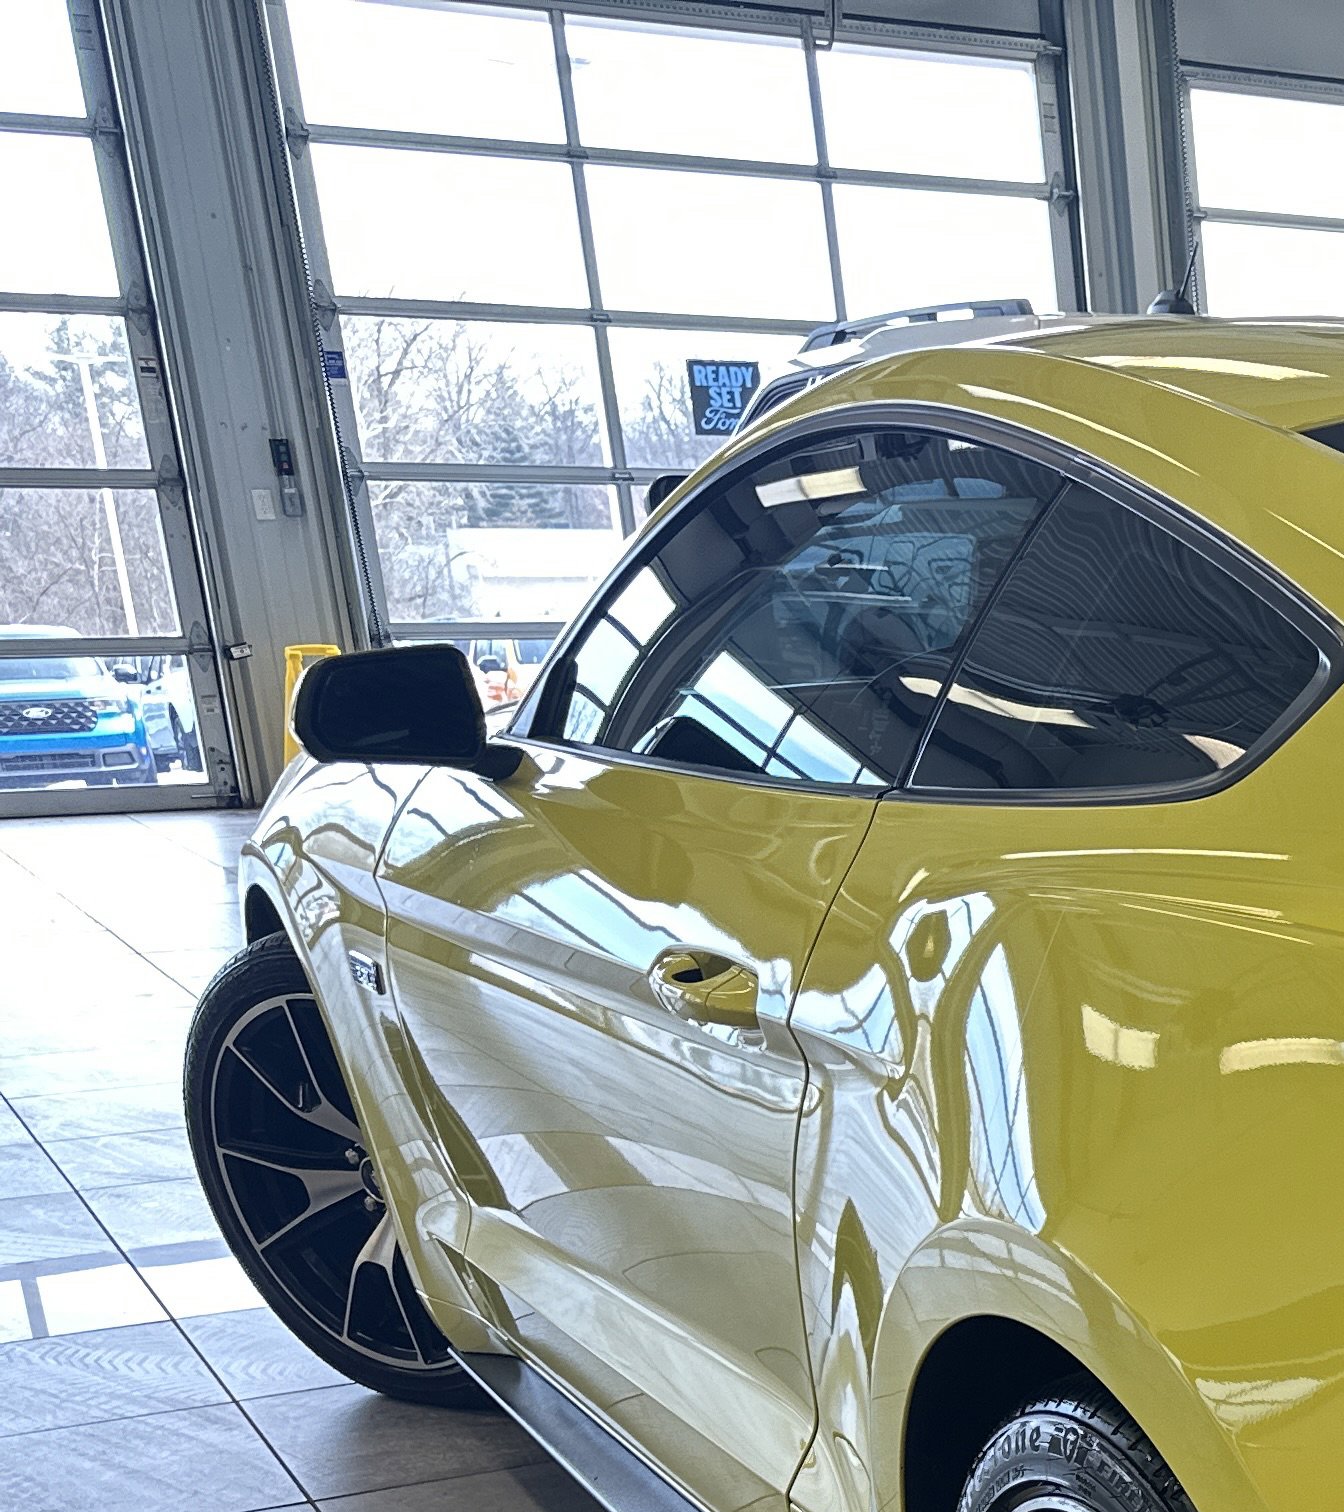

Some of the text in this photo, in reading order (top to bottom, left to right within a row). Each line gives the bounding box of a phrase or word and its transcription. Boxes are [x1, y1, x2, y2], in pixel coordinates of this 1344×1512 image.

[693, 365, 753, 388] READY
[708, 386, 743, 408] SET
[701, 406, 741, 431] For
